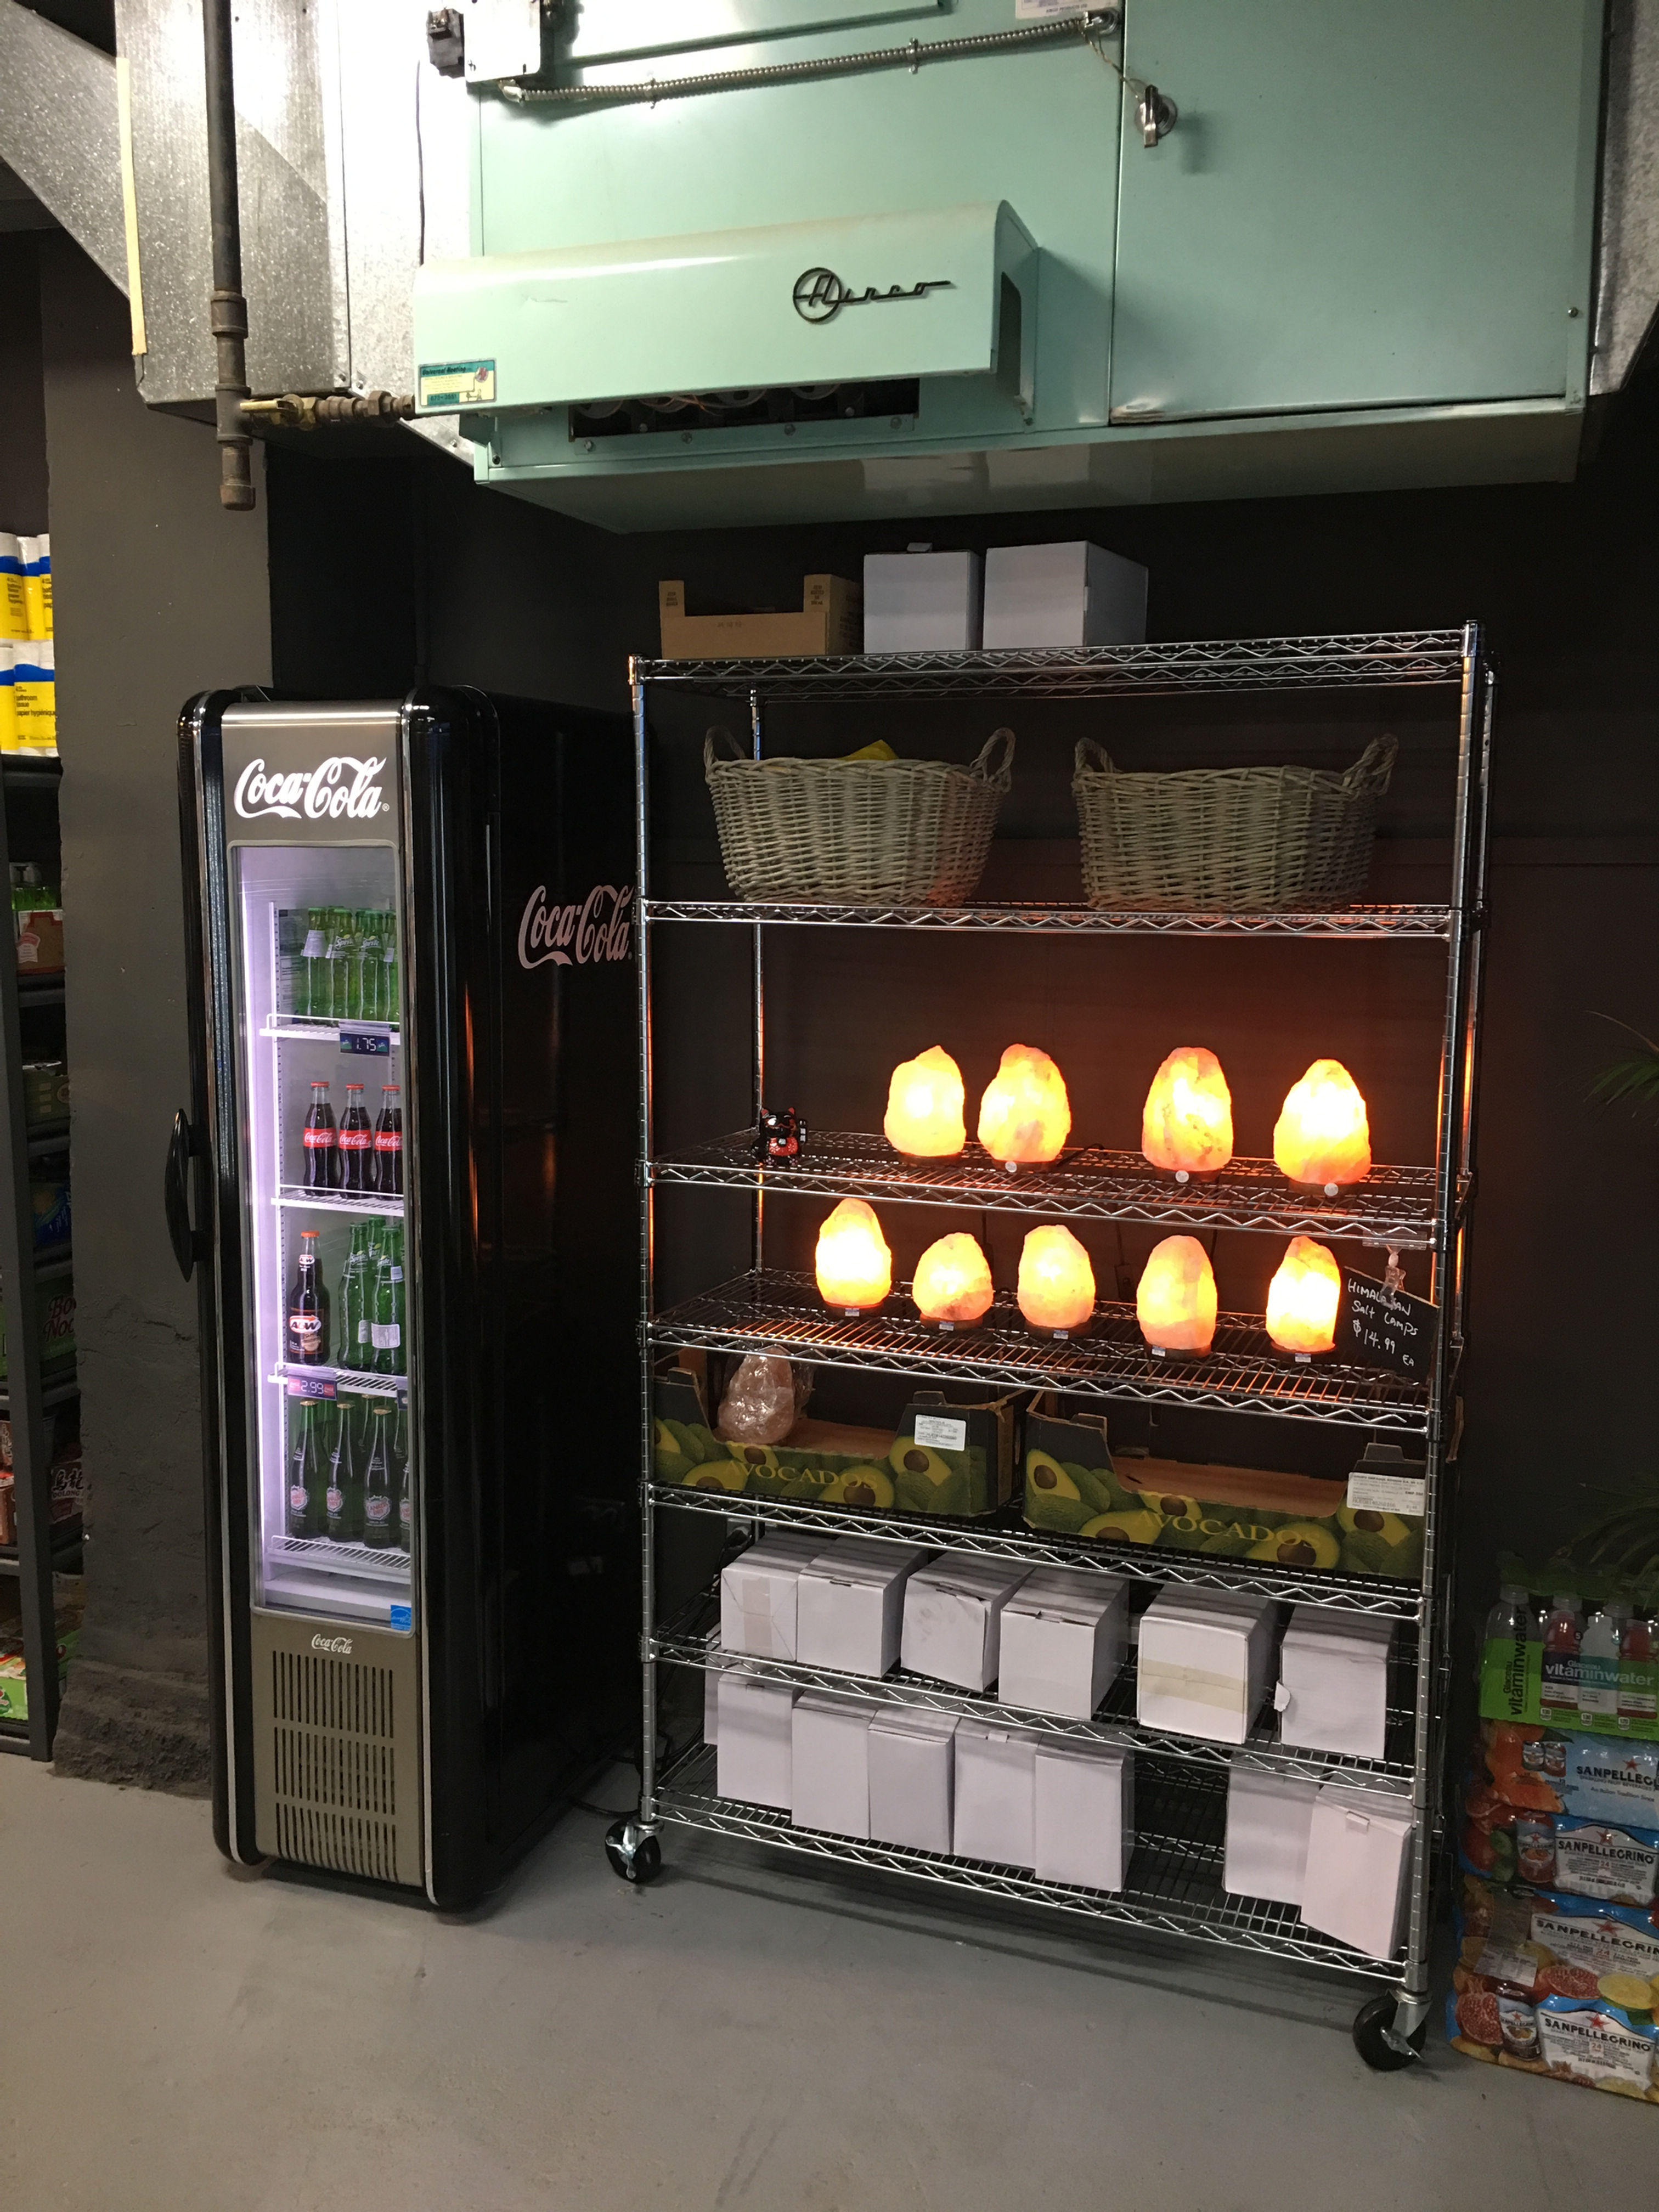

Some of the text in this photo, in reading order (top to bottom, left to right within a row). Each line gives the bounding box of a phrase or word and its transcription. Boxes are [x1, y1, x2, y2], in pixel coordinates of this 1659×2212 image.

[234, 757, 387, 819] Coca-Cola
[518, 885, 635, 969] Coca-Cola
[356, 1037, 376, 1051] 1.75
[1348, 1278, 1411, 1316] HIMALAAN
[1352, 1300, 1375, 1319] Salt
[1402, 1354, 1414, 1367] EA
[301, 1380, 324, 1395] 2.99
[724, 1460, 878, 1490] AVOCADOS
[1138, 1510, 1321, 1549] AVOCADOS
[311, 1633, 353, 1655] Coca-Cola
[1509, 1606, 1527, 1716] vitaminwater
[1545, 1663, 1655, 1686] vitaminwater
[1558, 1840, 1655, 1865] SANPELLEGRINO
[1545, 2018, 1651, 2052] SANPELLEGRINO
